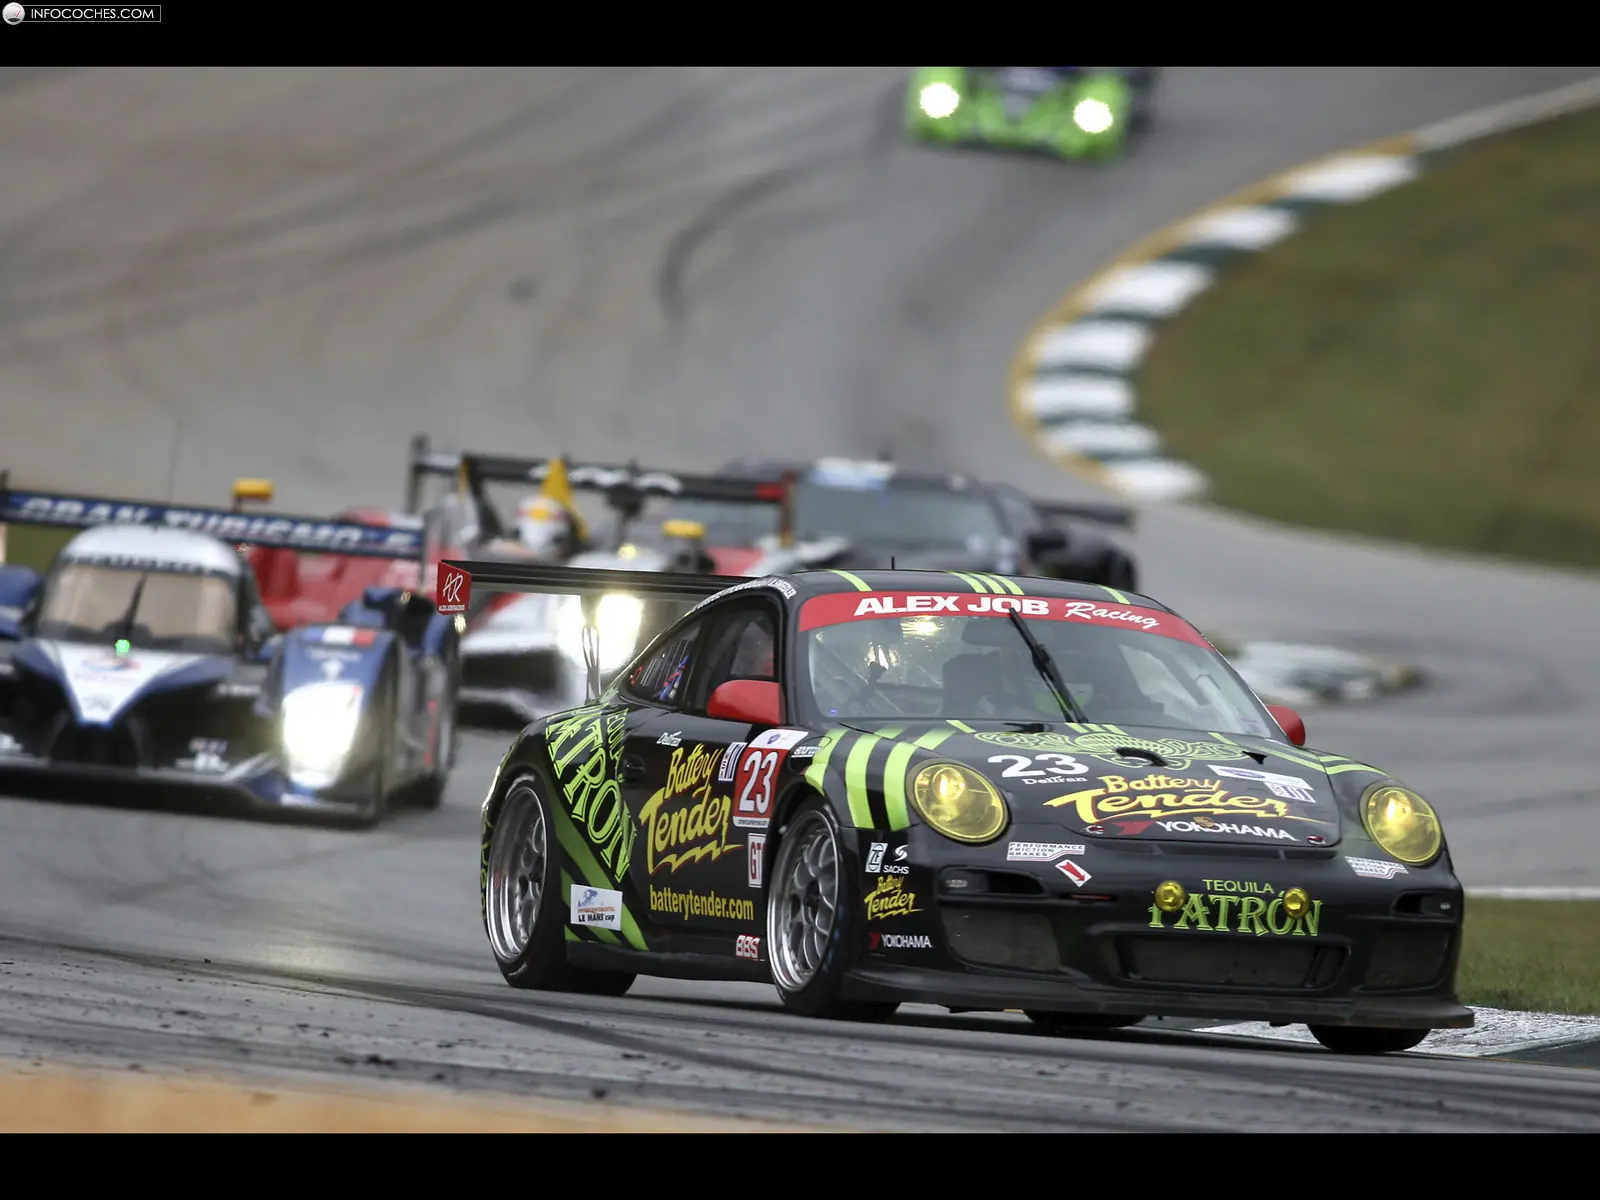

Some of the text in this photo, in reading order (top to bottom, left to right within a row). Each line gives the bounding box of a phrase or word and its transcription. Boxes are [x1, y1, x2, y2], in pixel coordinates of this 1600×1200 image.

[853, 596, 1160, 629] ALEX JOB Racing
[664, 743, 724, 799] Battery
[987, 753, 1090, 778] 23
[739, 750, 778, 814] 23
[1097, 774, 1222, 793] Battery
[1041, 788, 1289, 824] Tender
[640, 784, 731, 874] Tender
[1156, 821, 1297, 842] YOKOHAMA
[883, 864, 910, 875] SACHS
[1202, 878, 1275, 895] TEQUILA
[649, 884, 755, 921] batterytender.com
[863, 889, 917, 921] Tender
[736, 934, 761, 958] BBS
[881, 934, 933, 948] YOKOHAMA
